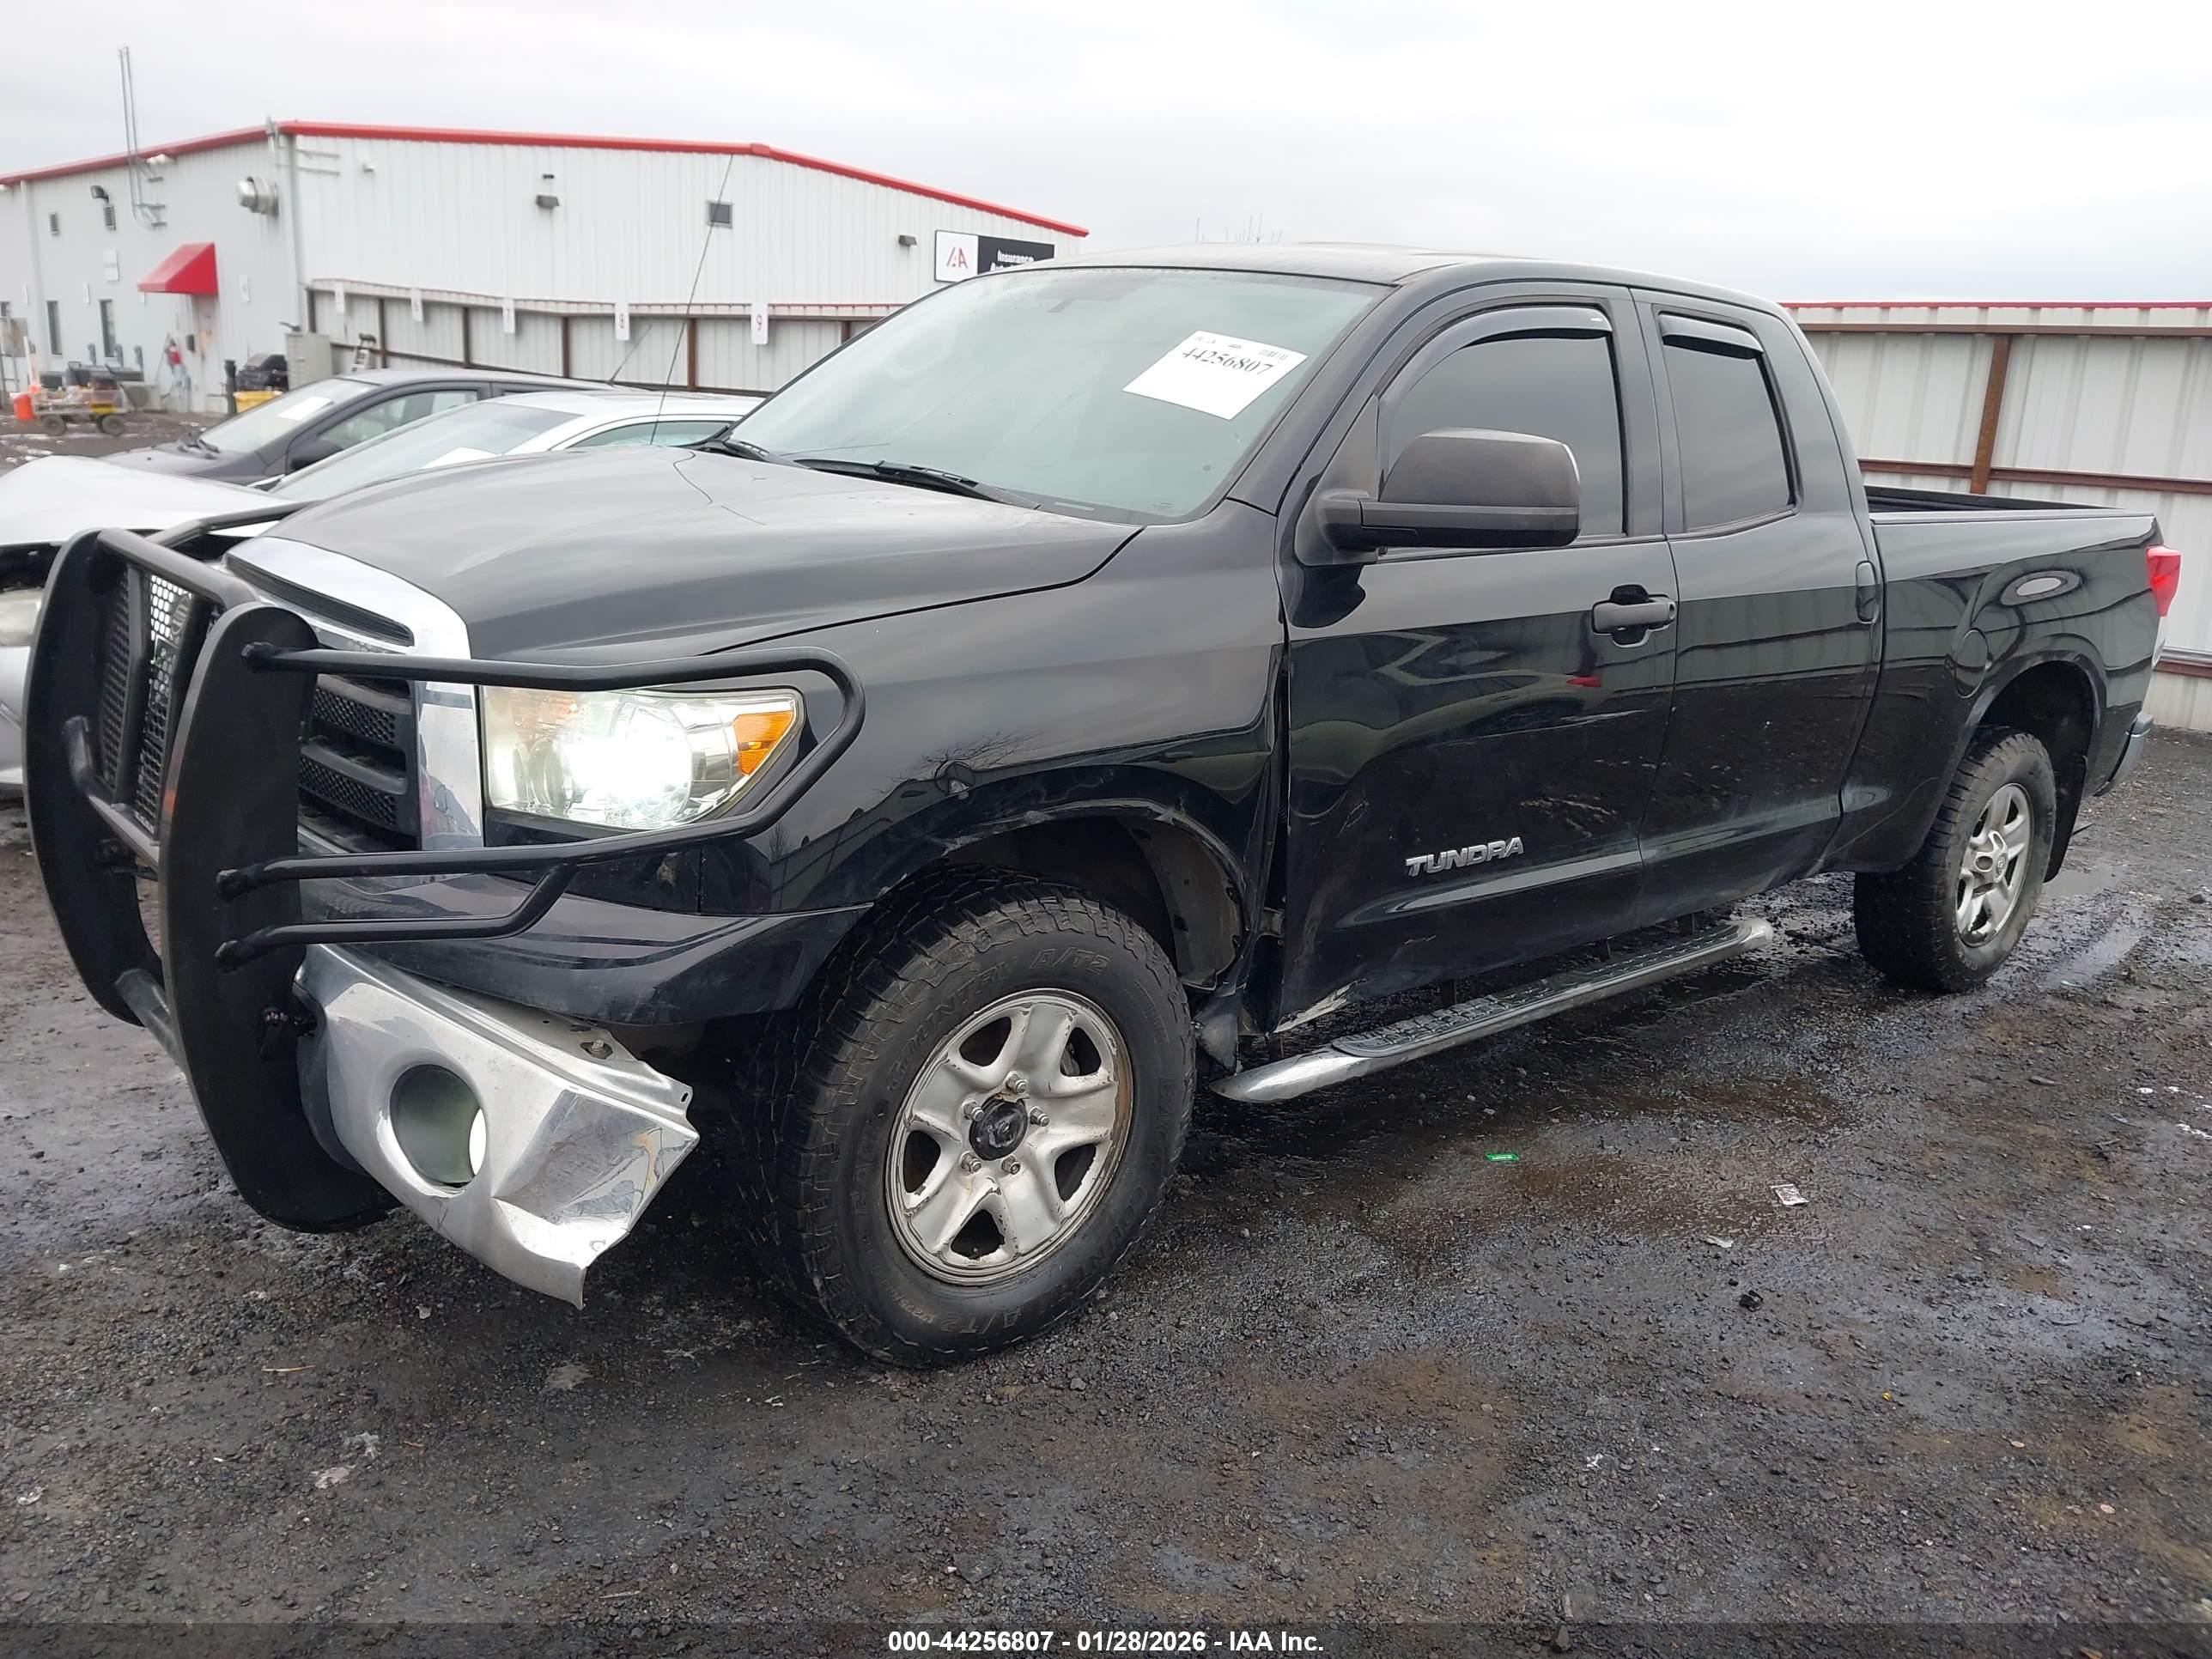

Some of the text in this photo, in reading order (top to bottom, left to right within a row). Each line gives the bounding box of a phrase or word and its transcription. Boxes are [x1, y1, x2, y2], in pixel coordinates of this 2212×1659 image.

[756, 313, 763, 331] 9
[1182, 347, 1274, 374] 44256807
[1406, 836, 1525, 878] TUNDRA
